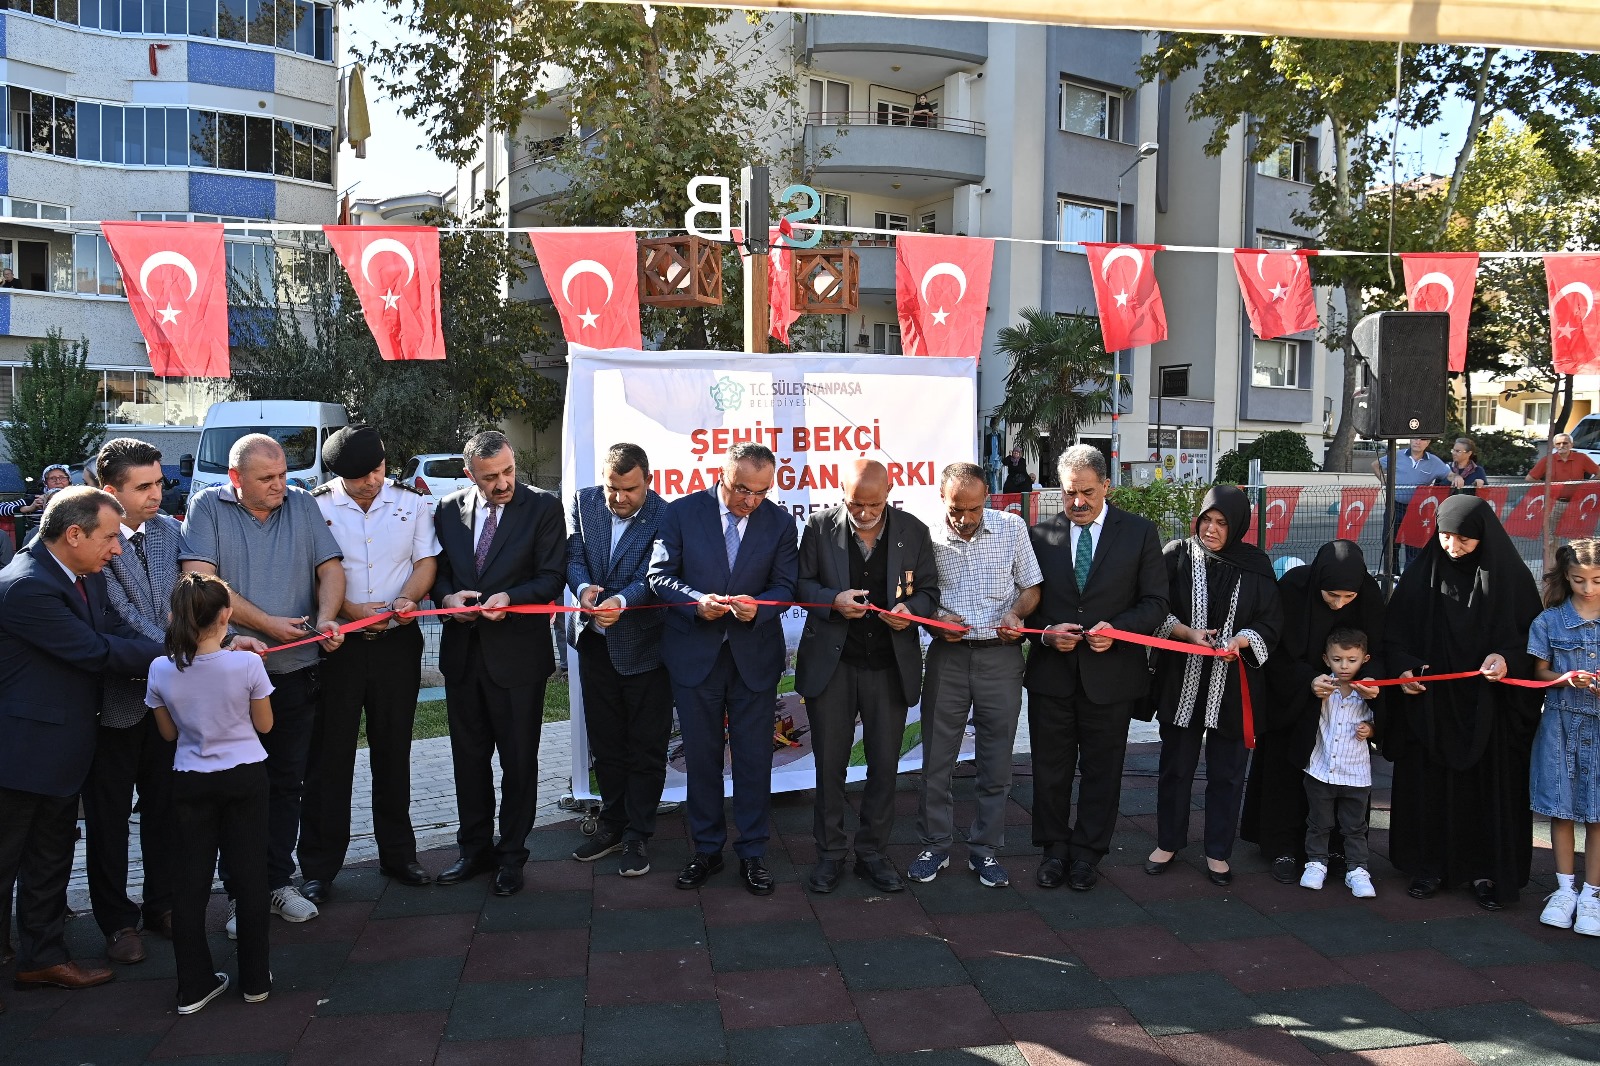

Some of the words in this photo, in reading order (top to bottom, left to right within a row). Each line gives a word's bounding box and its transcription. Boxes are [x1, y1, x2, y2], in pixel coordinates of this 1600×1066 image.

[750, 383, 769, 396] T.C.
[772, 380, 863, 397] SÜLEYMANPAŞA
[750, 398, 812, 408] BELEDİYESİ
[691, 421, 783, 461] ŞEHİT
[793, 419, 880, 457] BEKÇİ
[649, 467, 723, 495] IRAT
[770, 457, 839, 490] ĞAN
[886, 461, 935, 487] RKI
